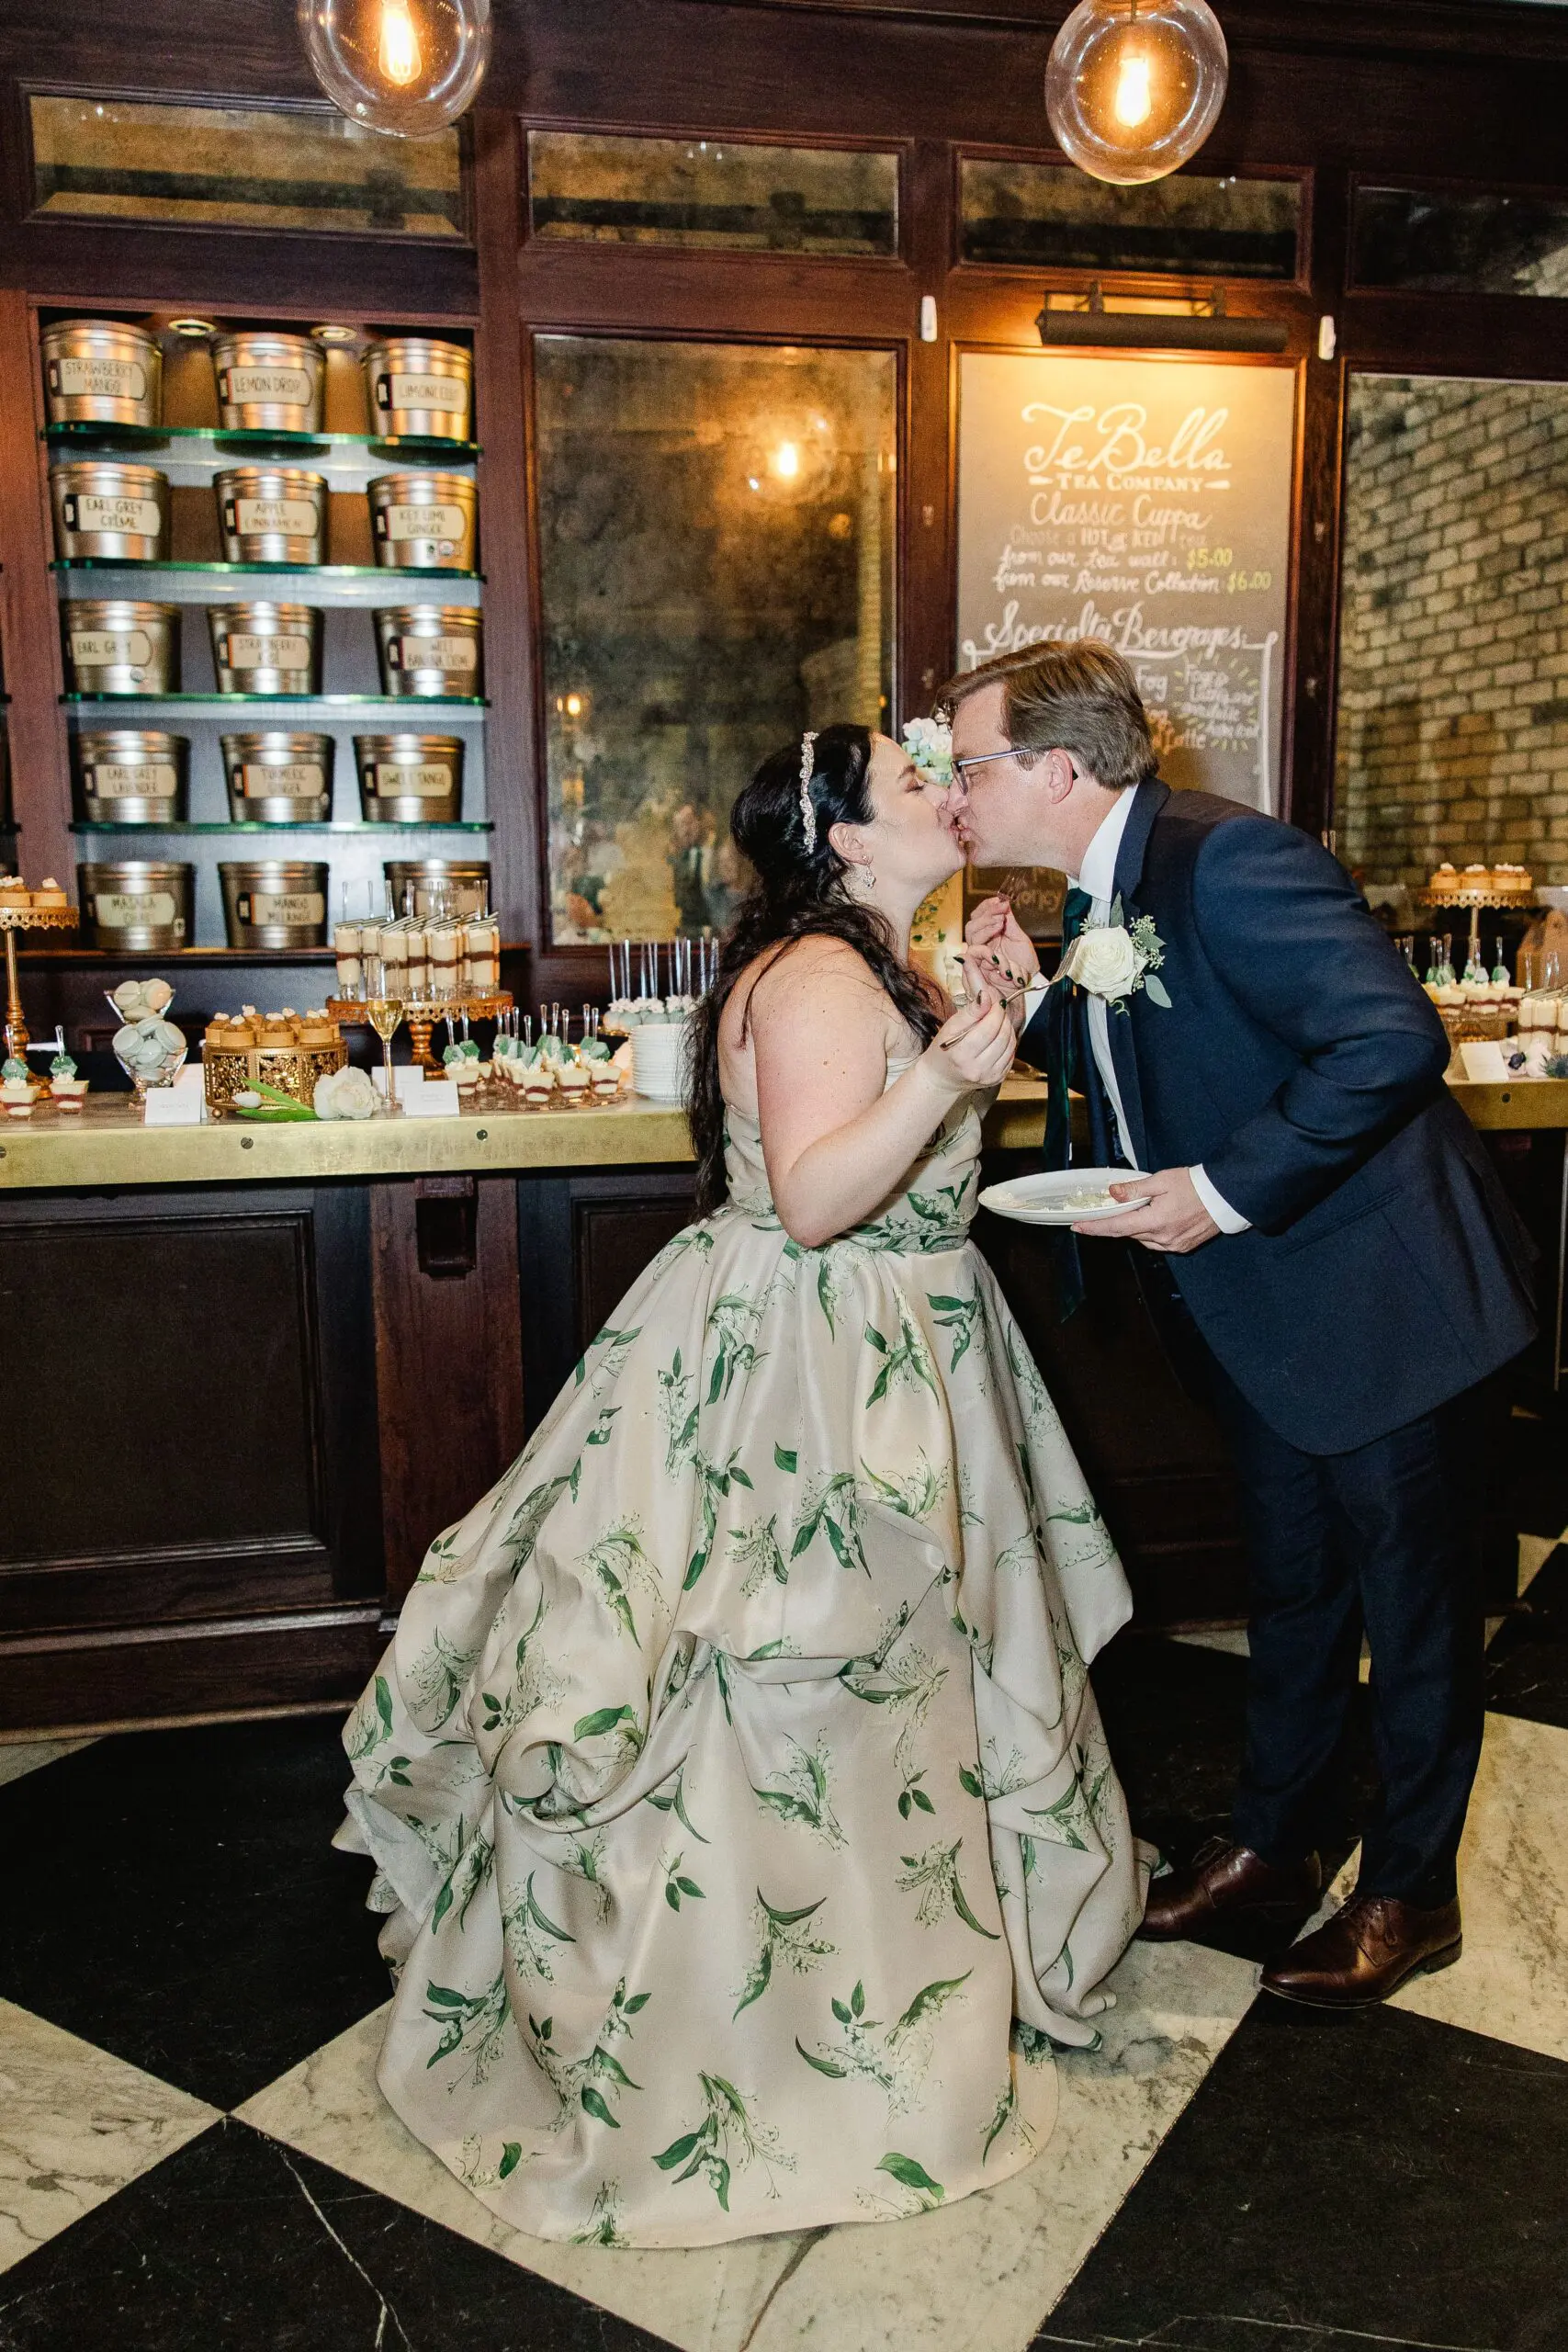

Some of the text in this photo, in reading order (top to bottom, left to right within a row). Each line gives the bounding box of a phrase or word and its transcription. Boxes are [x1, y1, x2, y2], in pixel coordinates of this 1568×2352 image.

[233, 376, 272, 393] LEMON
[85, 498, 143, 515] EARL GREY
[1029, 490, 1213, 543] Classic Cuppa
[999, 543, 1043, 568] from
[1186, 547, 1234, 571] $5.00
[1073, 569, 1141, 594] Reserve
[1145, 570, 1221, 594] Collection
[1227, 571, 1272, 594] $6.00
[103, 639, 132, 654] GRY
